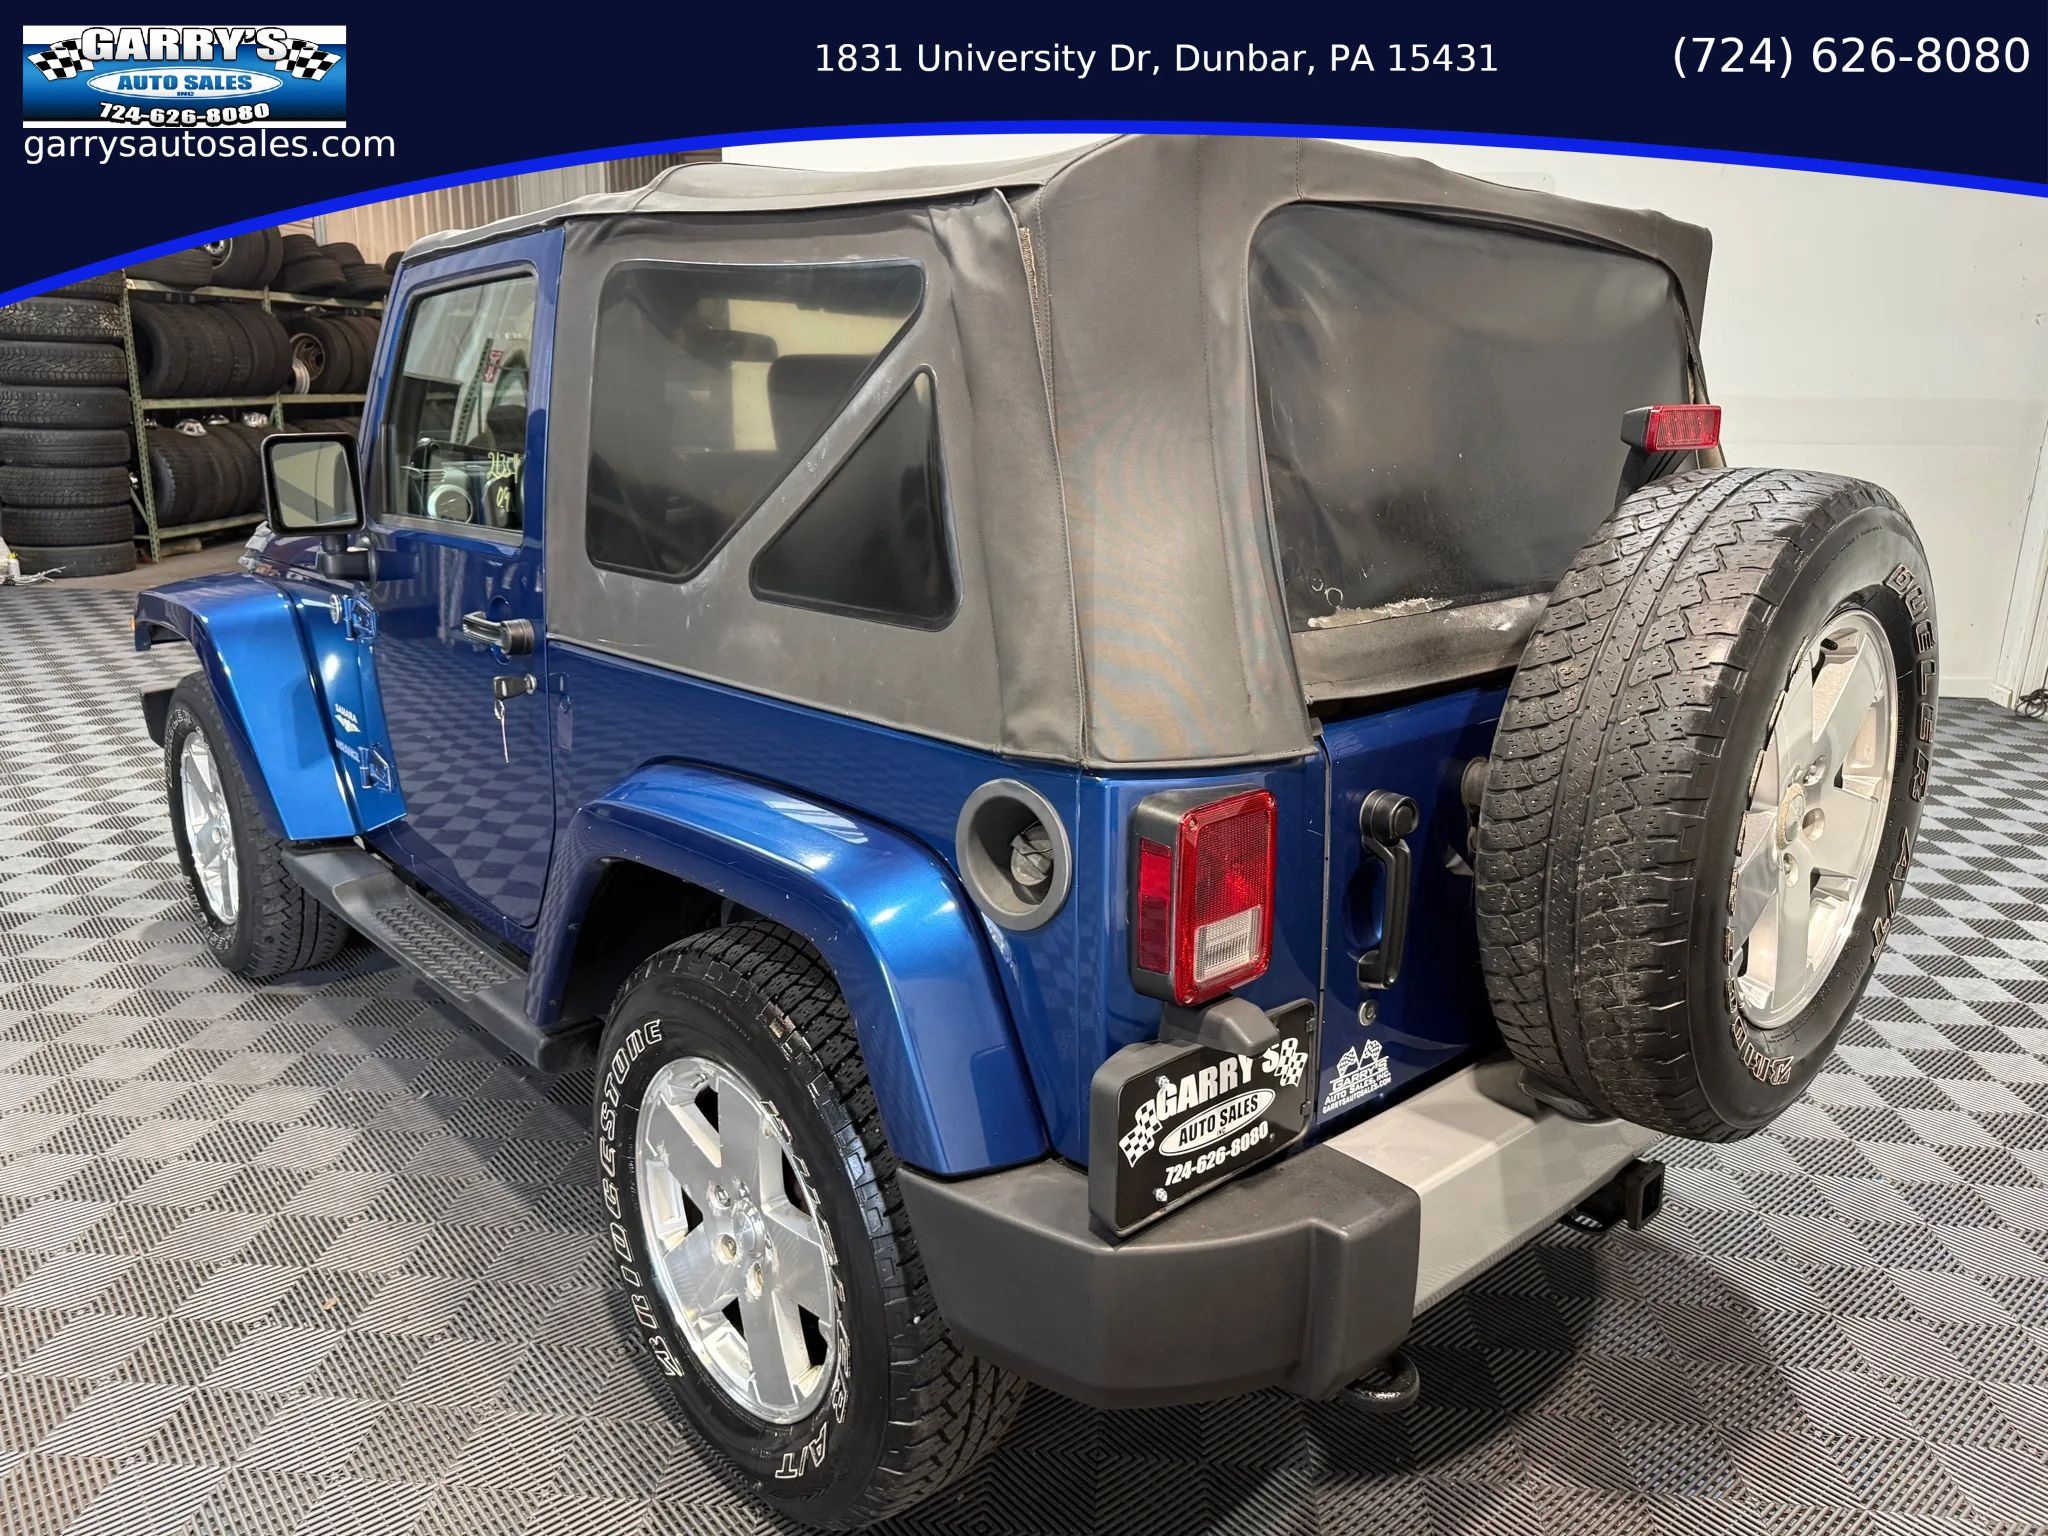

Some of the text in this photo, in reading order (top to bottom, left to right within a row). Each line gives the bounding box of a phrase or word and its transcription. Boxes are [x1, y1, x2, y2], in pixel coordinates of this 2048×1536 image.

[1882, 563, 1937, 802] DUELER
[1324, 1090, 1347, 1106] AUTO
[1332, 1061, 1388, 1092] GARRY'S
[1178, 1094, 1259, 1147] AUTO SALES
[1165, 1121, 1269, 1187] 724-626-8080
[599, 1017, 686, 1380] BRIDGESTONE
[775, 1422, 829, 1480] A/T
